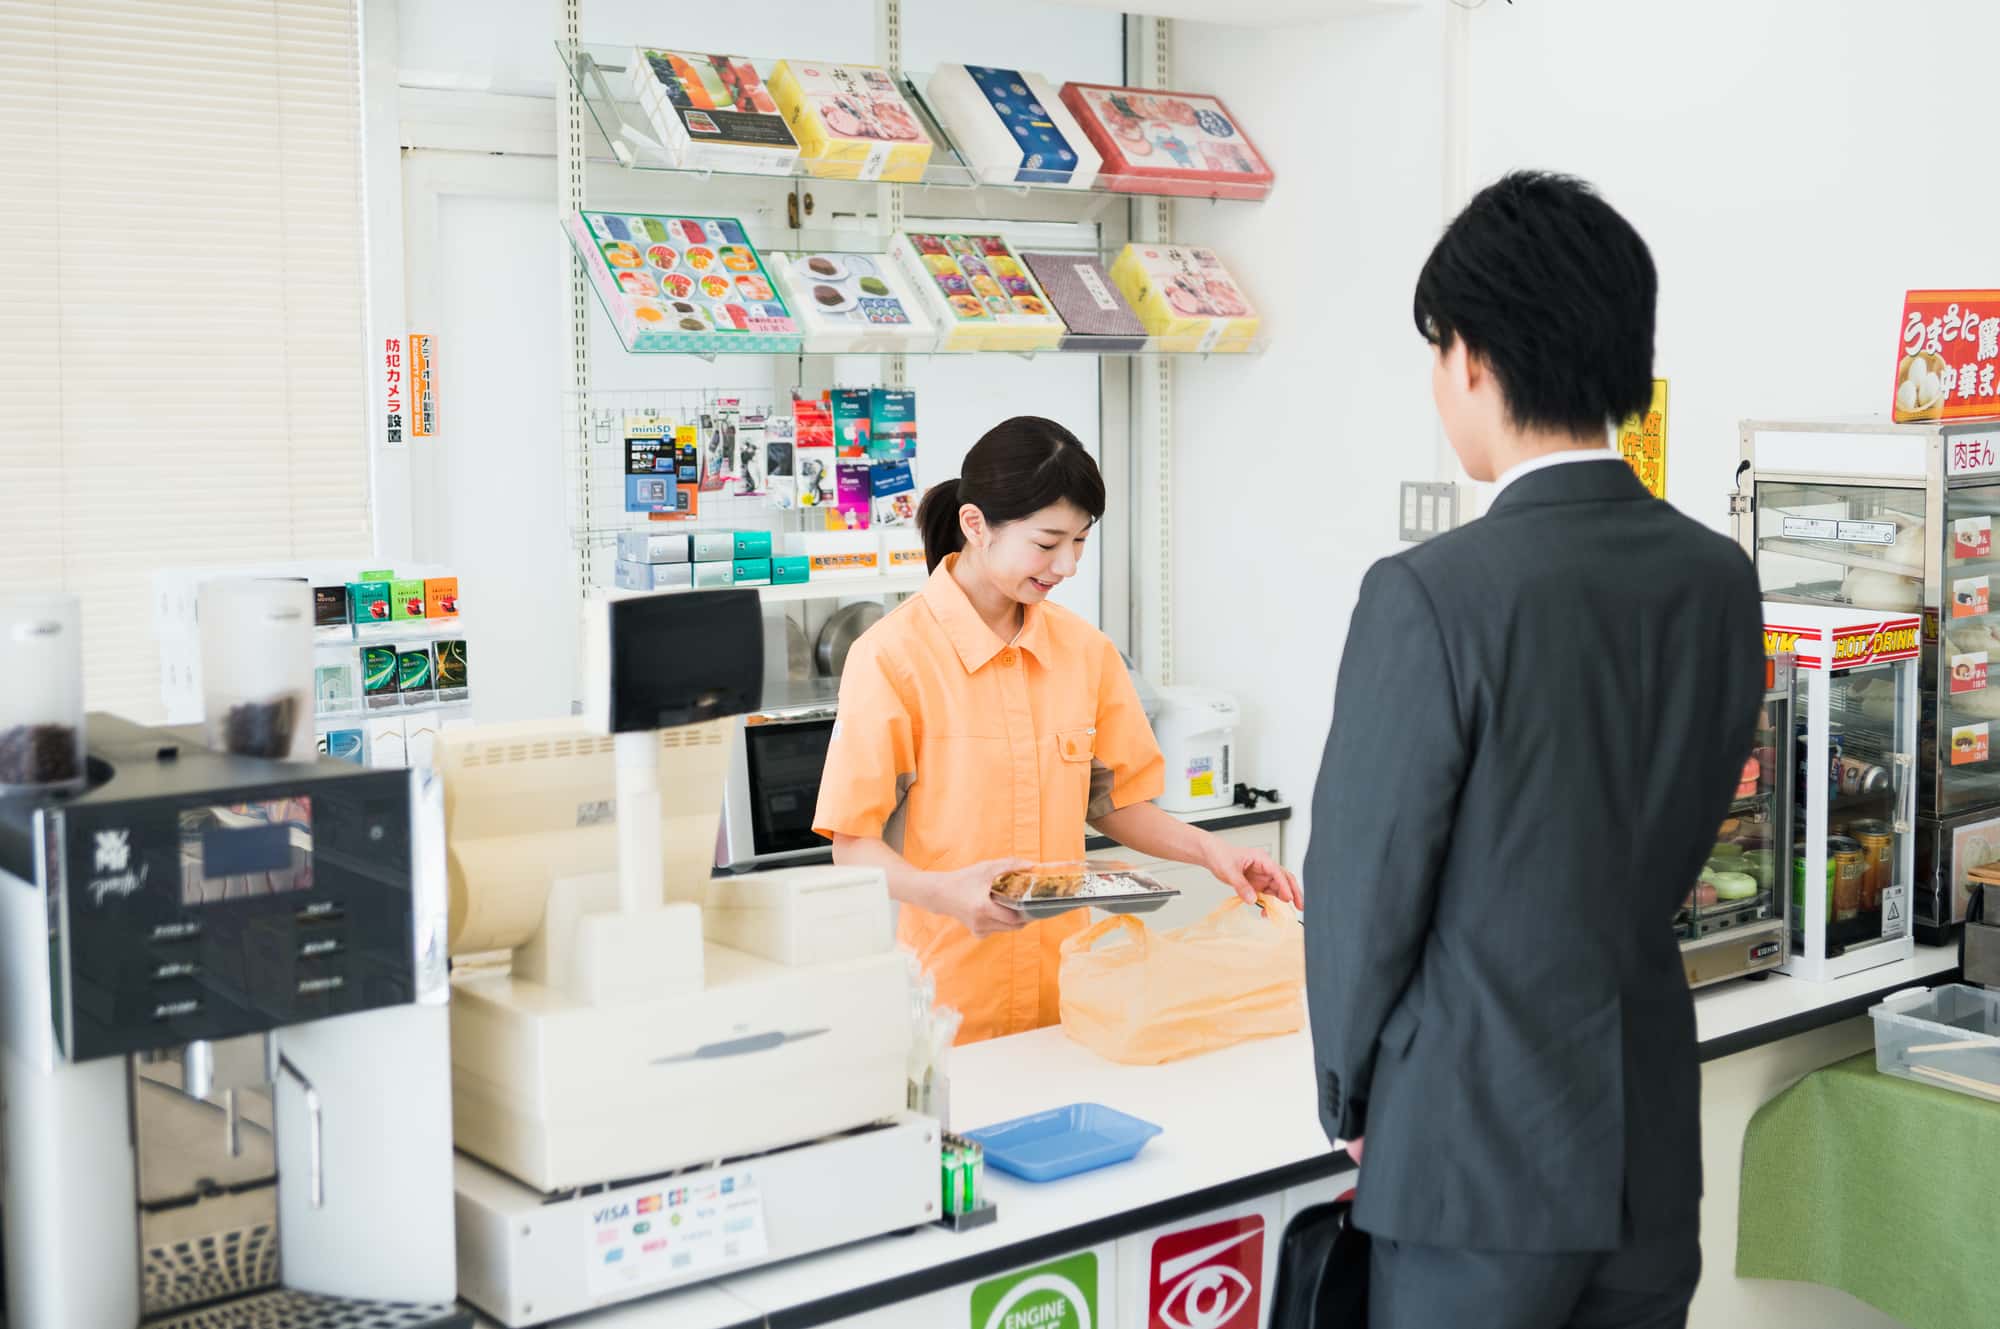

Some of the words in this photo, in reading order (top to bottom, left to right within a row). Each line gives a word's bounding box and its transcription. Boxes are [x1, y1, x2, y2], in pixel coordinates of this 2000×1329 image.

[385, 338, 402, 443] 防犯カメラ設置
[1941, 363, 2000, 400] 中華ま
[631, 424, 671, 434] miniSD
[1954, 440, 1995, 470] 肉まん
[1872, 627, 1917, 654] DRINK
[593, 1203, 630, 1224] VISA
[1004, 1298, 1067, 1329] ENGINE
